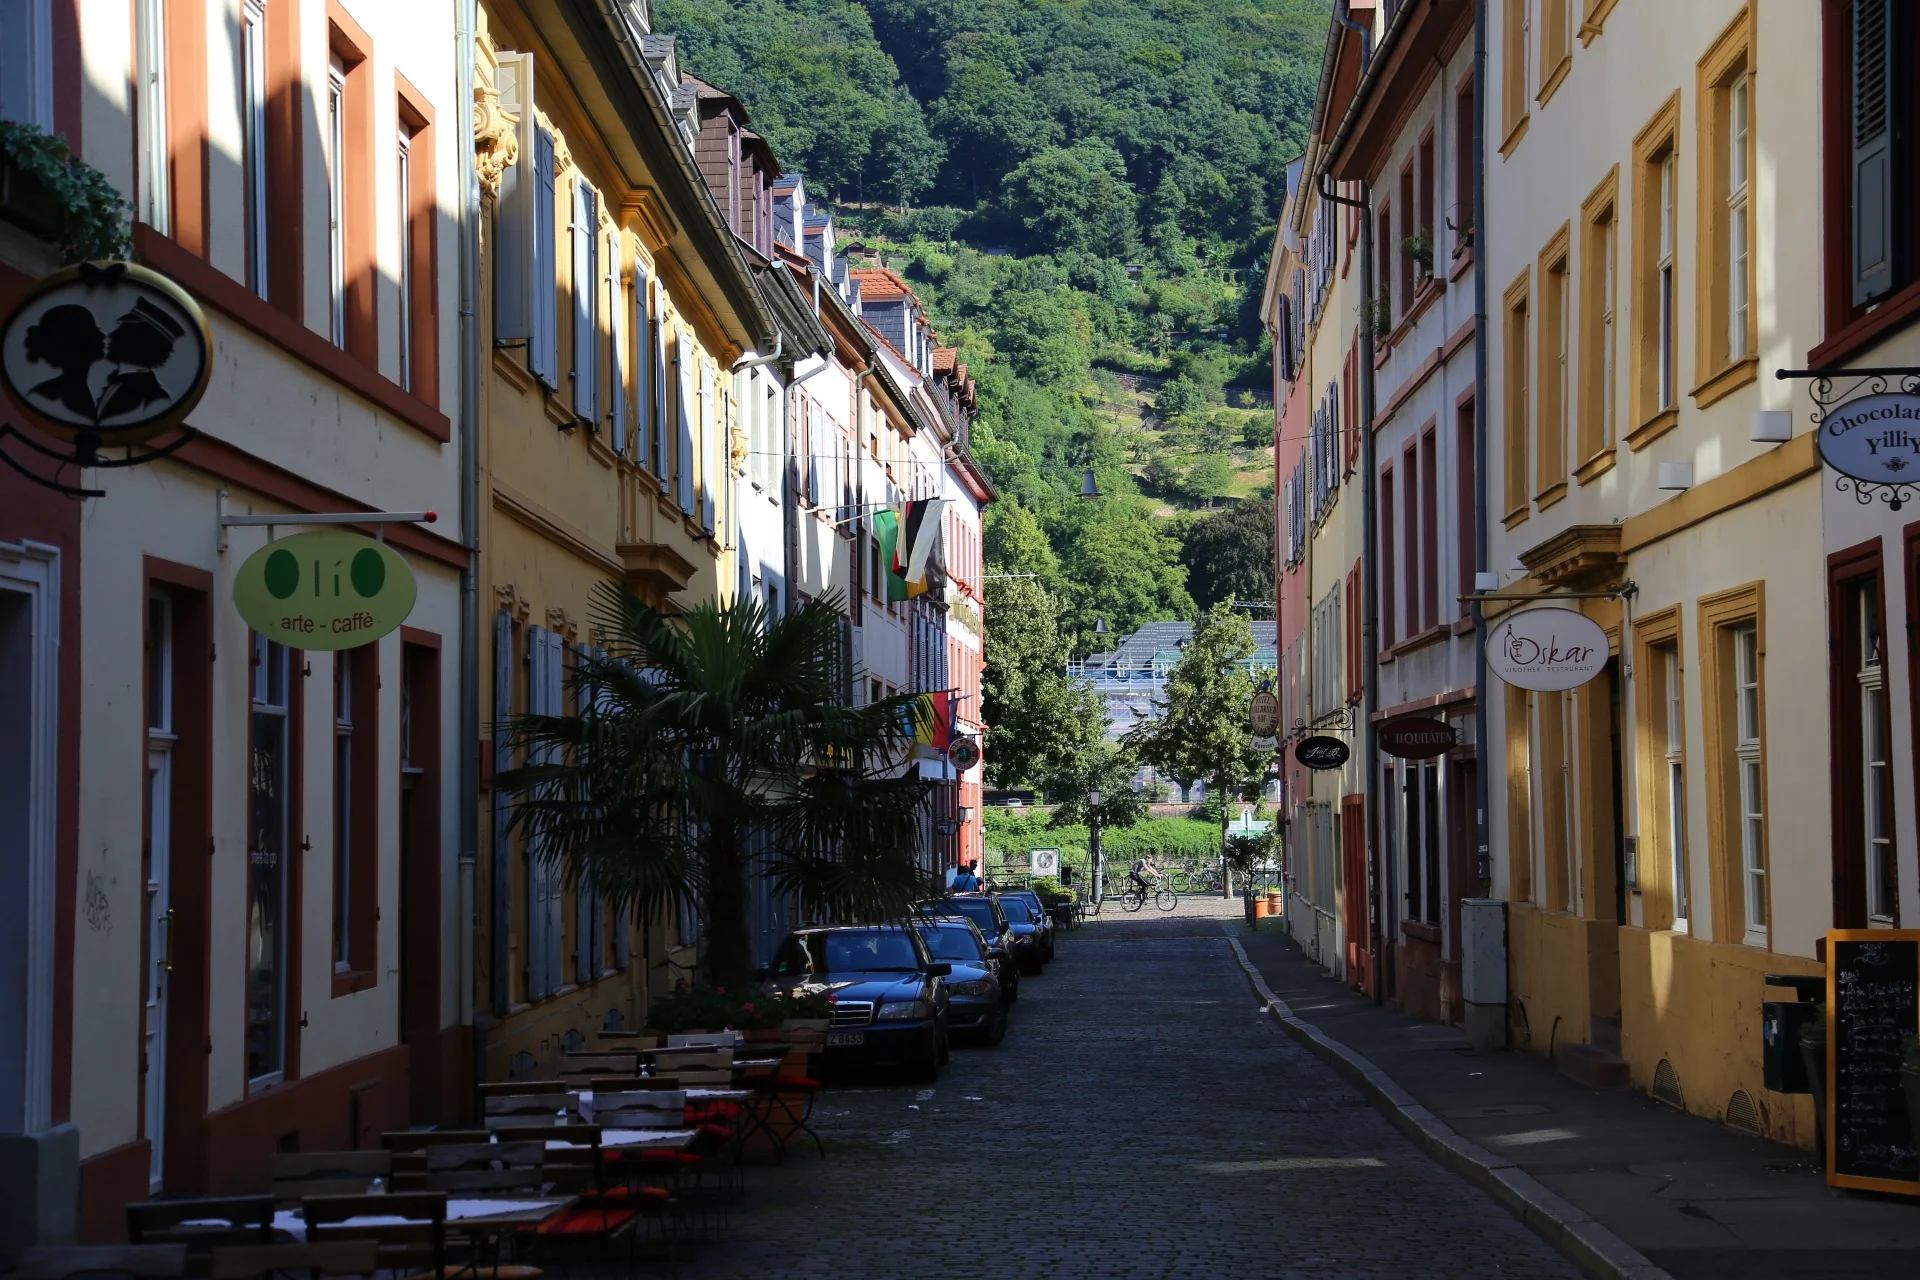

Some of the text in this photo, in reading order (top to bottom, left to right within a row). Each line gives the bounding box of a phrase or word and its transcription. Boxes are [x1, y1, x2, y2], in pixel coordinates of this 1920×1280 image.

[281, 614, 314, 633] arte
[332, 612, 374, 634] caffè
[1510, 635, 1594, 665] Oskar
[838, 1034, 862, 1043] 8433
